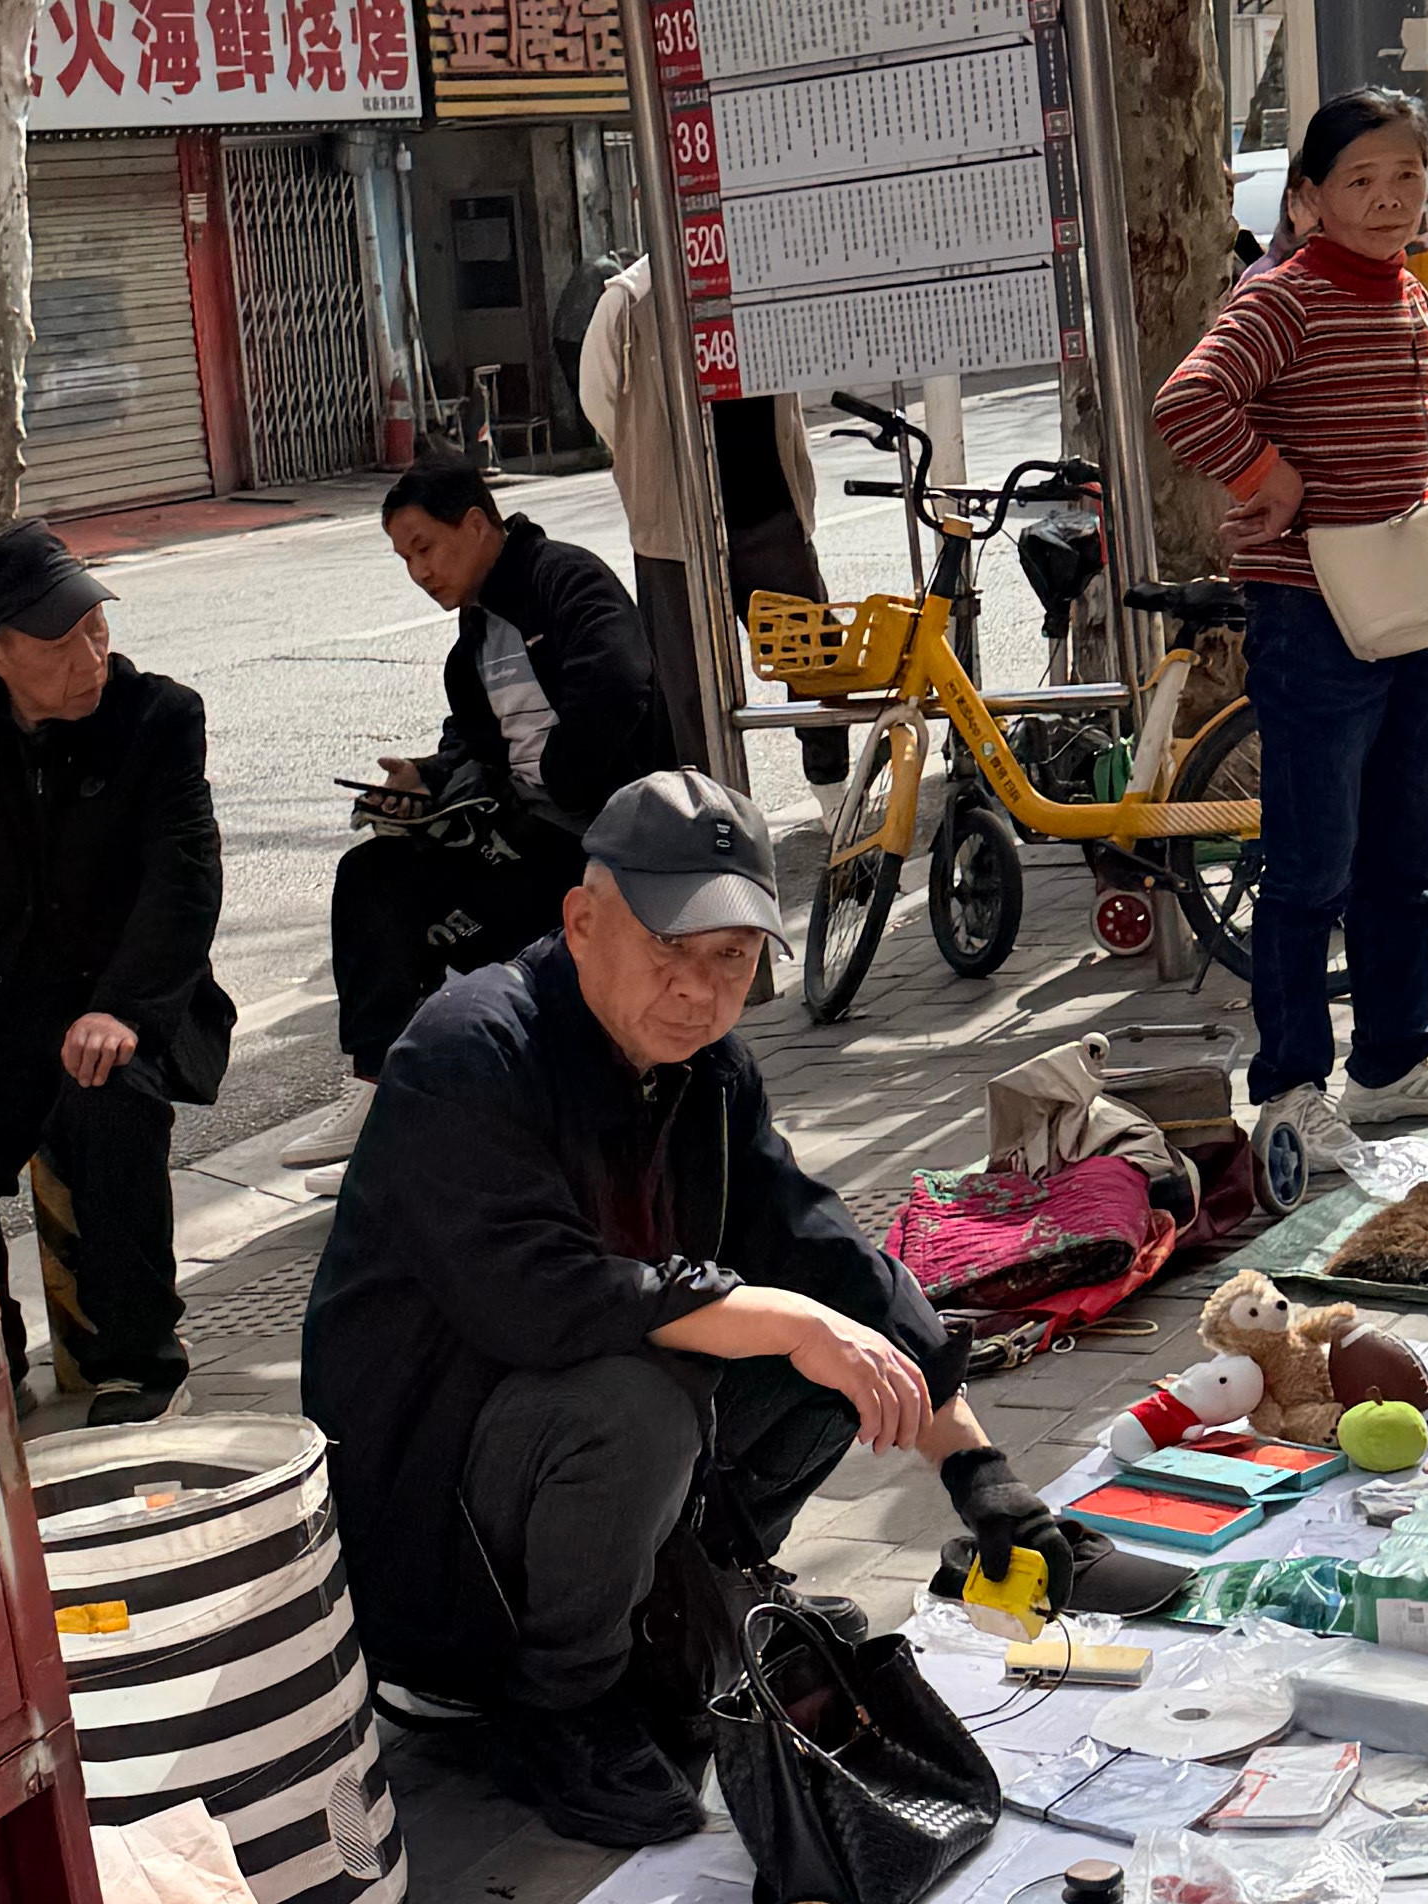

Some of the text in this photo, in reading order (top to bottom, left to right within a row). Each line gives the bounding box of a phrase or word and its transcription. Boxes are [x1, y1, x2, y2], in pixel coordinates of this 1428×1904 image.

[677, 121, 711, 164] 38
[685, 223, 727, 268] 520
[694, 330, 737, 374] 548
